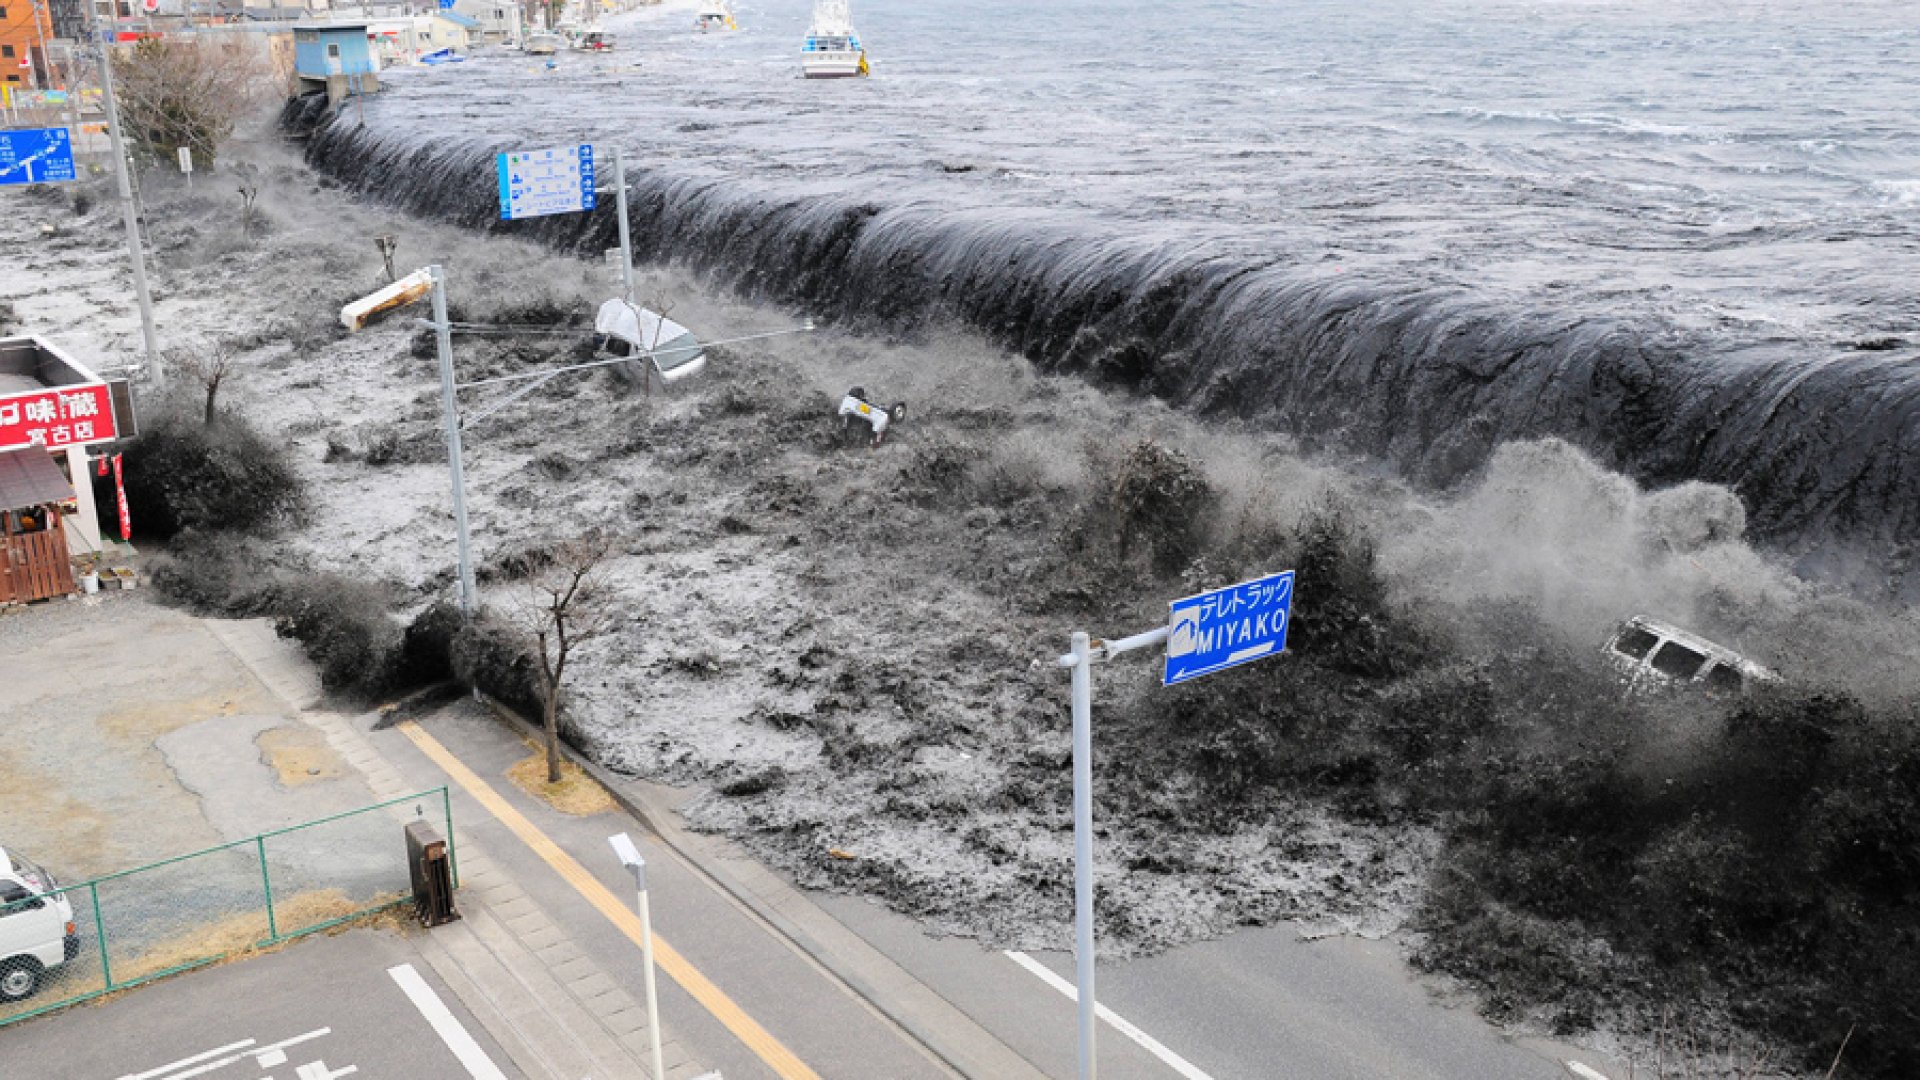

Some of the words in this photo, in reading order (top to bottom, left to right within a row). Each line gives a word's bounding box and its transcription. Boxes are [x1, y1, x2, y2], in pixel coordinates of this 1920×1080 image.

[26, 420, 94, 445] 宮古店
[1200, 576, 1291, 622] テレトラック
[1197, 608, 1285, 656] MIYAKO
